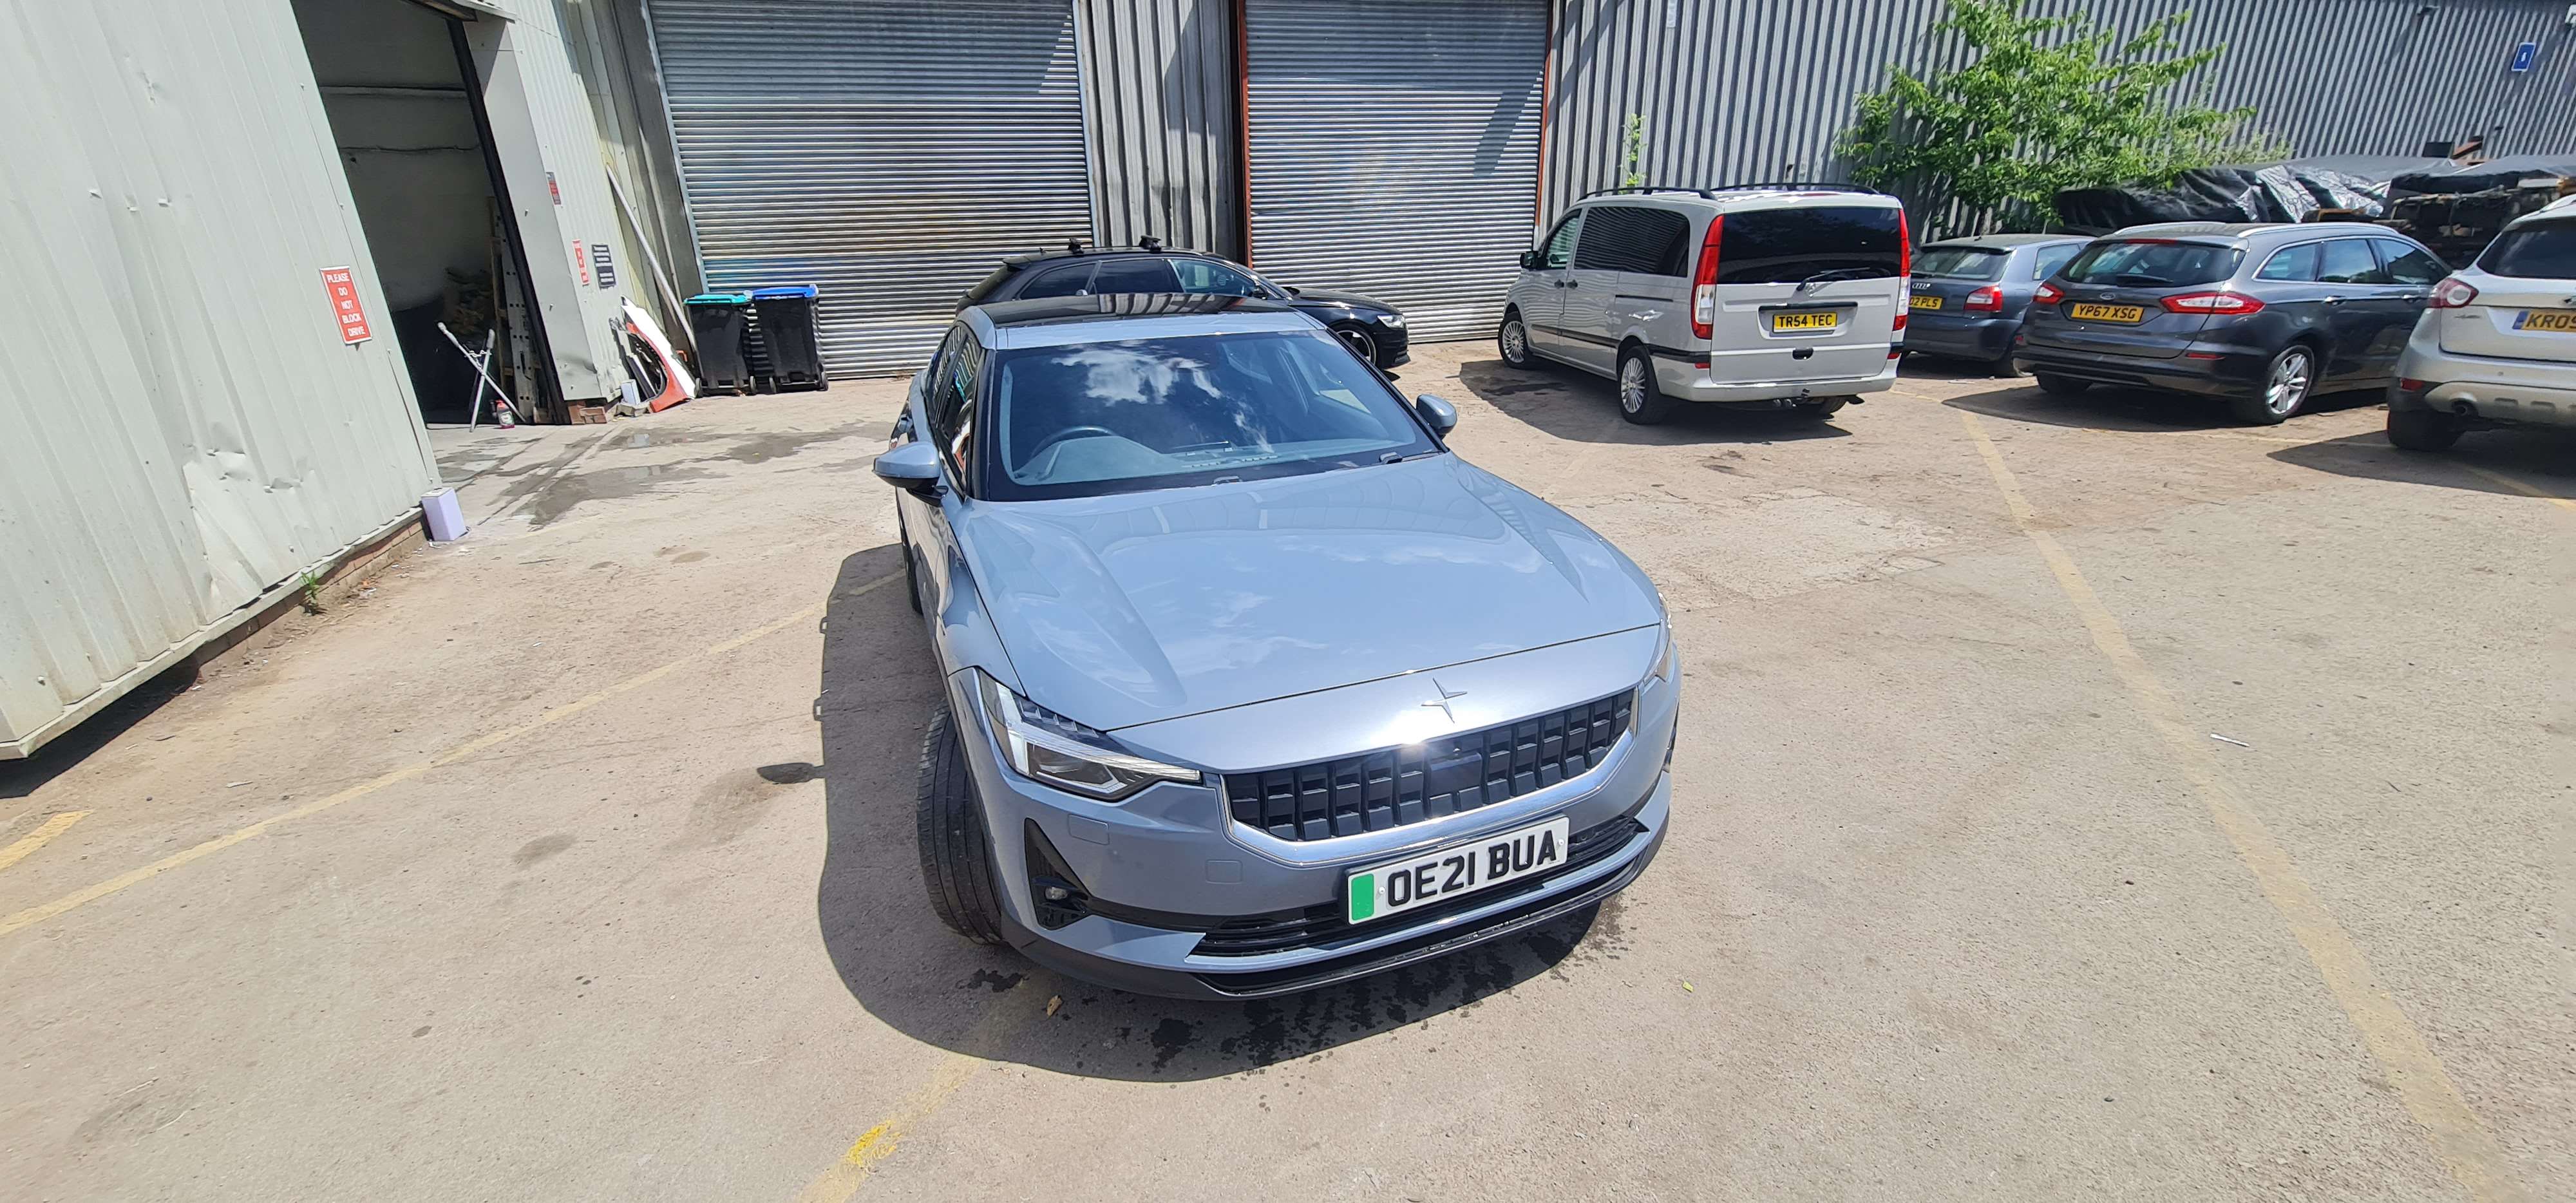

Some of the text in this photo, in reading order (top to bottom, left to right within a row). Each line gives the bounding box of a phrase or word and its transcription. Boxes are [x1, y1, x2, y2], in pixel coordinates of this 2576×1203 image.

[327, 272, 350, 283] PLEASE
[337, 287, 348, 296] DO
[341, 299, 354, 310] NOT
[1920, 298, 1938, 308] PLS
[2079, 305, 2137, 319] YP67 XSG
[341, 313, 362, 324] BLOCK
[1779, 314, 1833, 328] TR54 TEC
[348, 326, 366, 337] DRIVE
[1387, 829, 1557, 909] OE21 BUA
